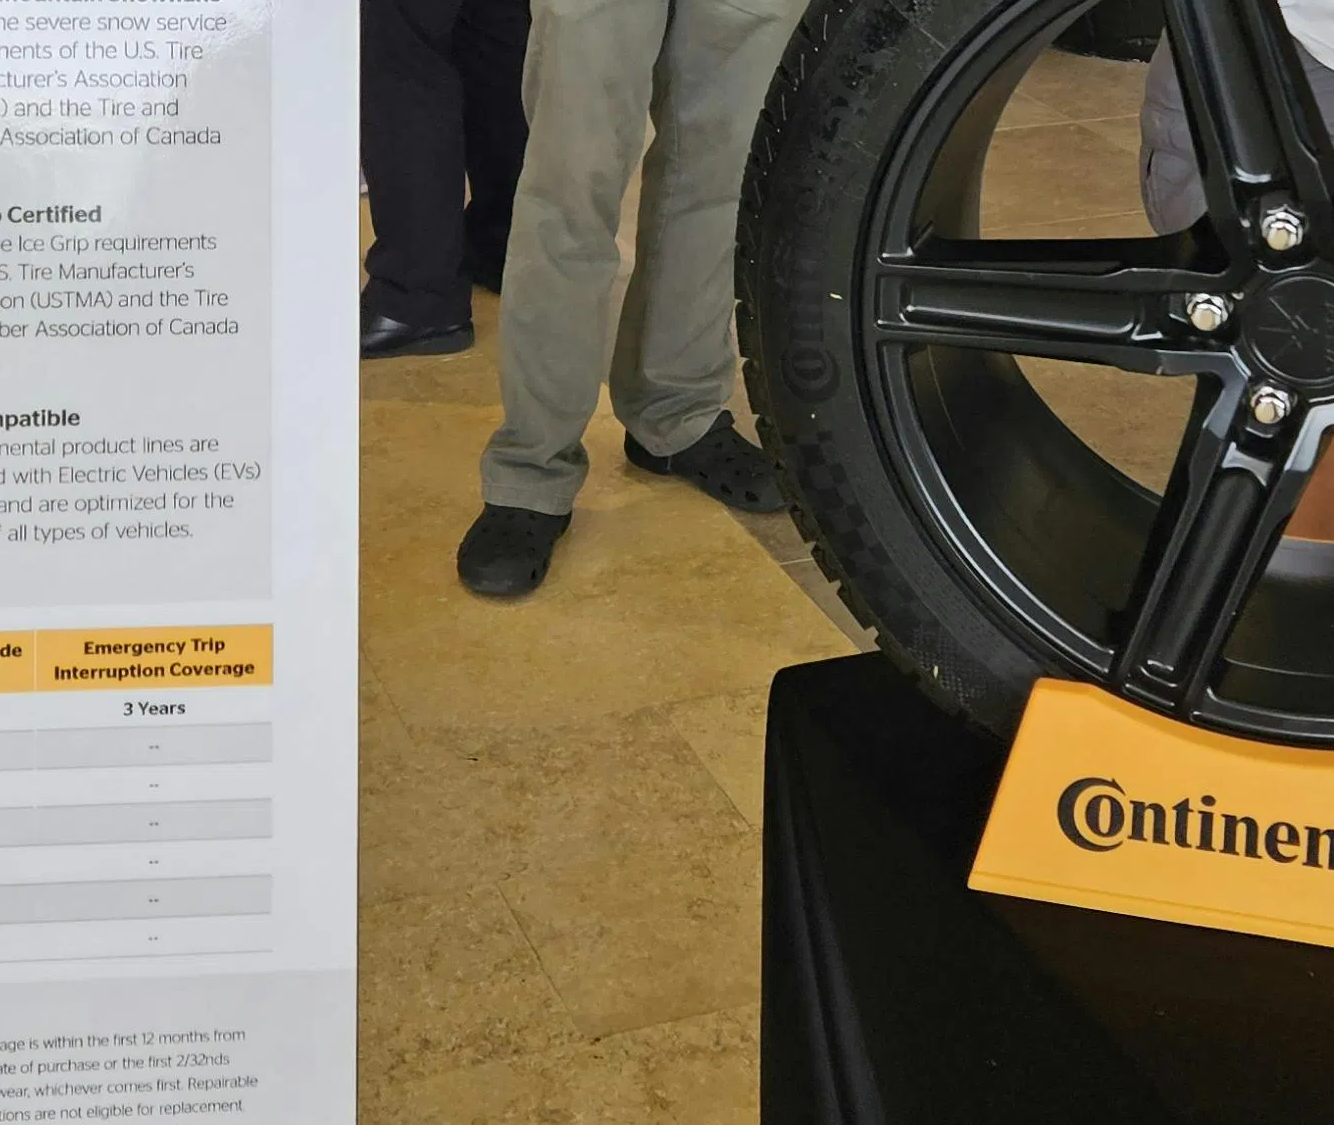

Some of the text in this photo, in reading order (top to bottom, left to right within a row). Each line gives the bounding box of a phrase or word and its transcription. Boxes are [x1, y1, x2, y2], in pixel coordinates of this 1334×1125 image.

[6, 204, 102, 224] Certified
[83, 636, 226, 658] Emergency Trip
[54, 661, 255, 682] Interruption Coverage
[19, 1059, 34, 1075] of
[37, 1058, 101, 1076] purchase
[103, 1059, 118, 1071] or
[122, 1056, 145, 1071] the
[148, 1054, 173, 1069] first
[176, 1051, 231, 1068] 2/32nds
